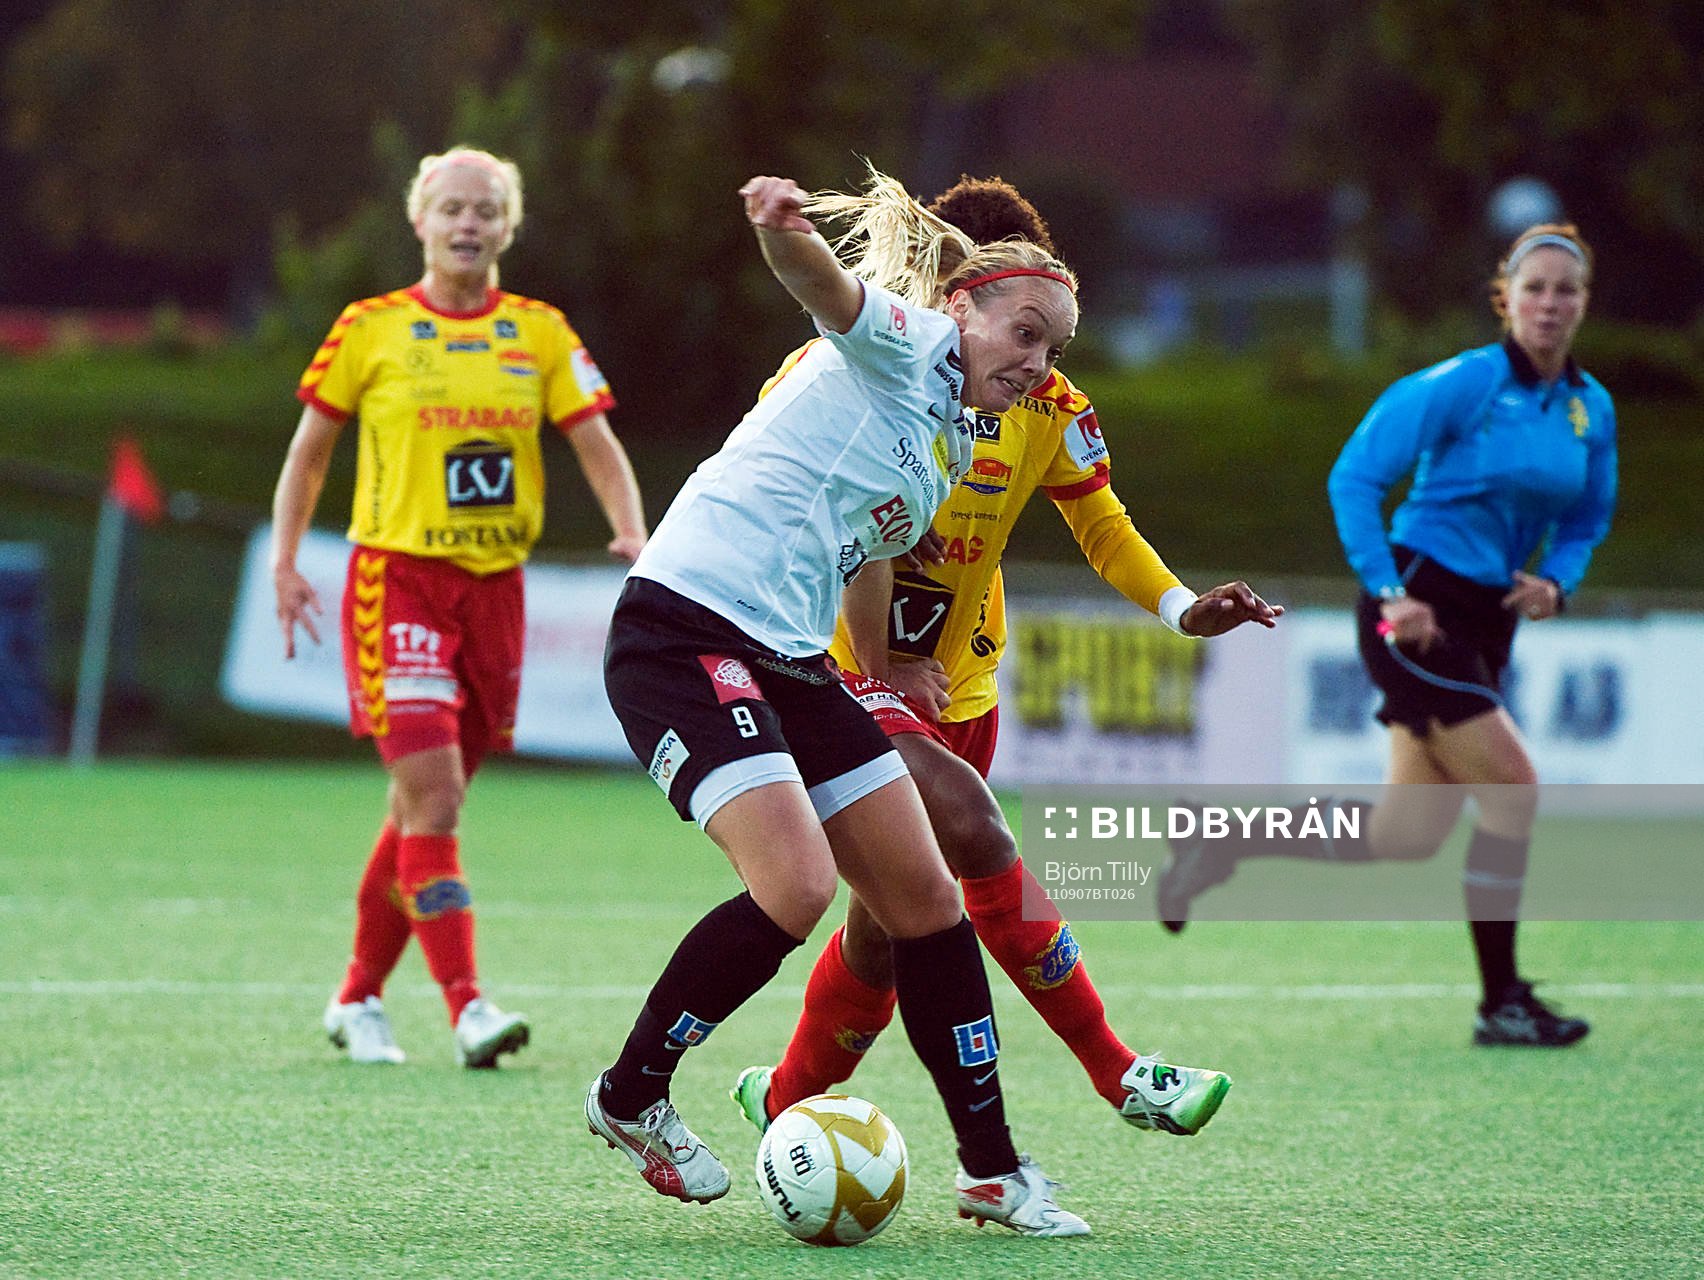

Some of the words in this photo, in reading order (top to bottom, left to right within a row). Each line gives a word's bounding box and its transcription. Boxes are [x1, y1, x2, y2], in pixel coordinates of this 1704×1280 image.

[418, 406, 536, 429] STRABAG
[1016, 396, 1057, 421] TANA
[448, 457, 513, 502] LV
[732, 706, 759, 738] 9
[652, 736, 677, 780] STARKA
